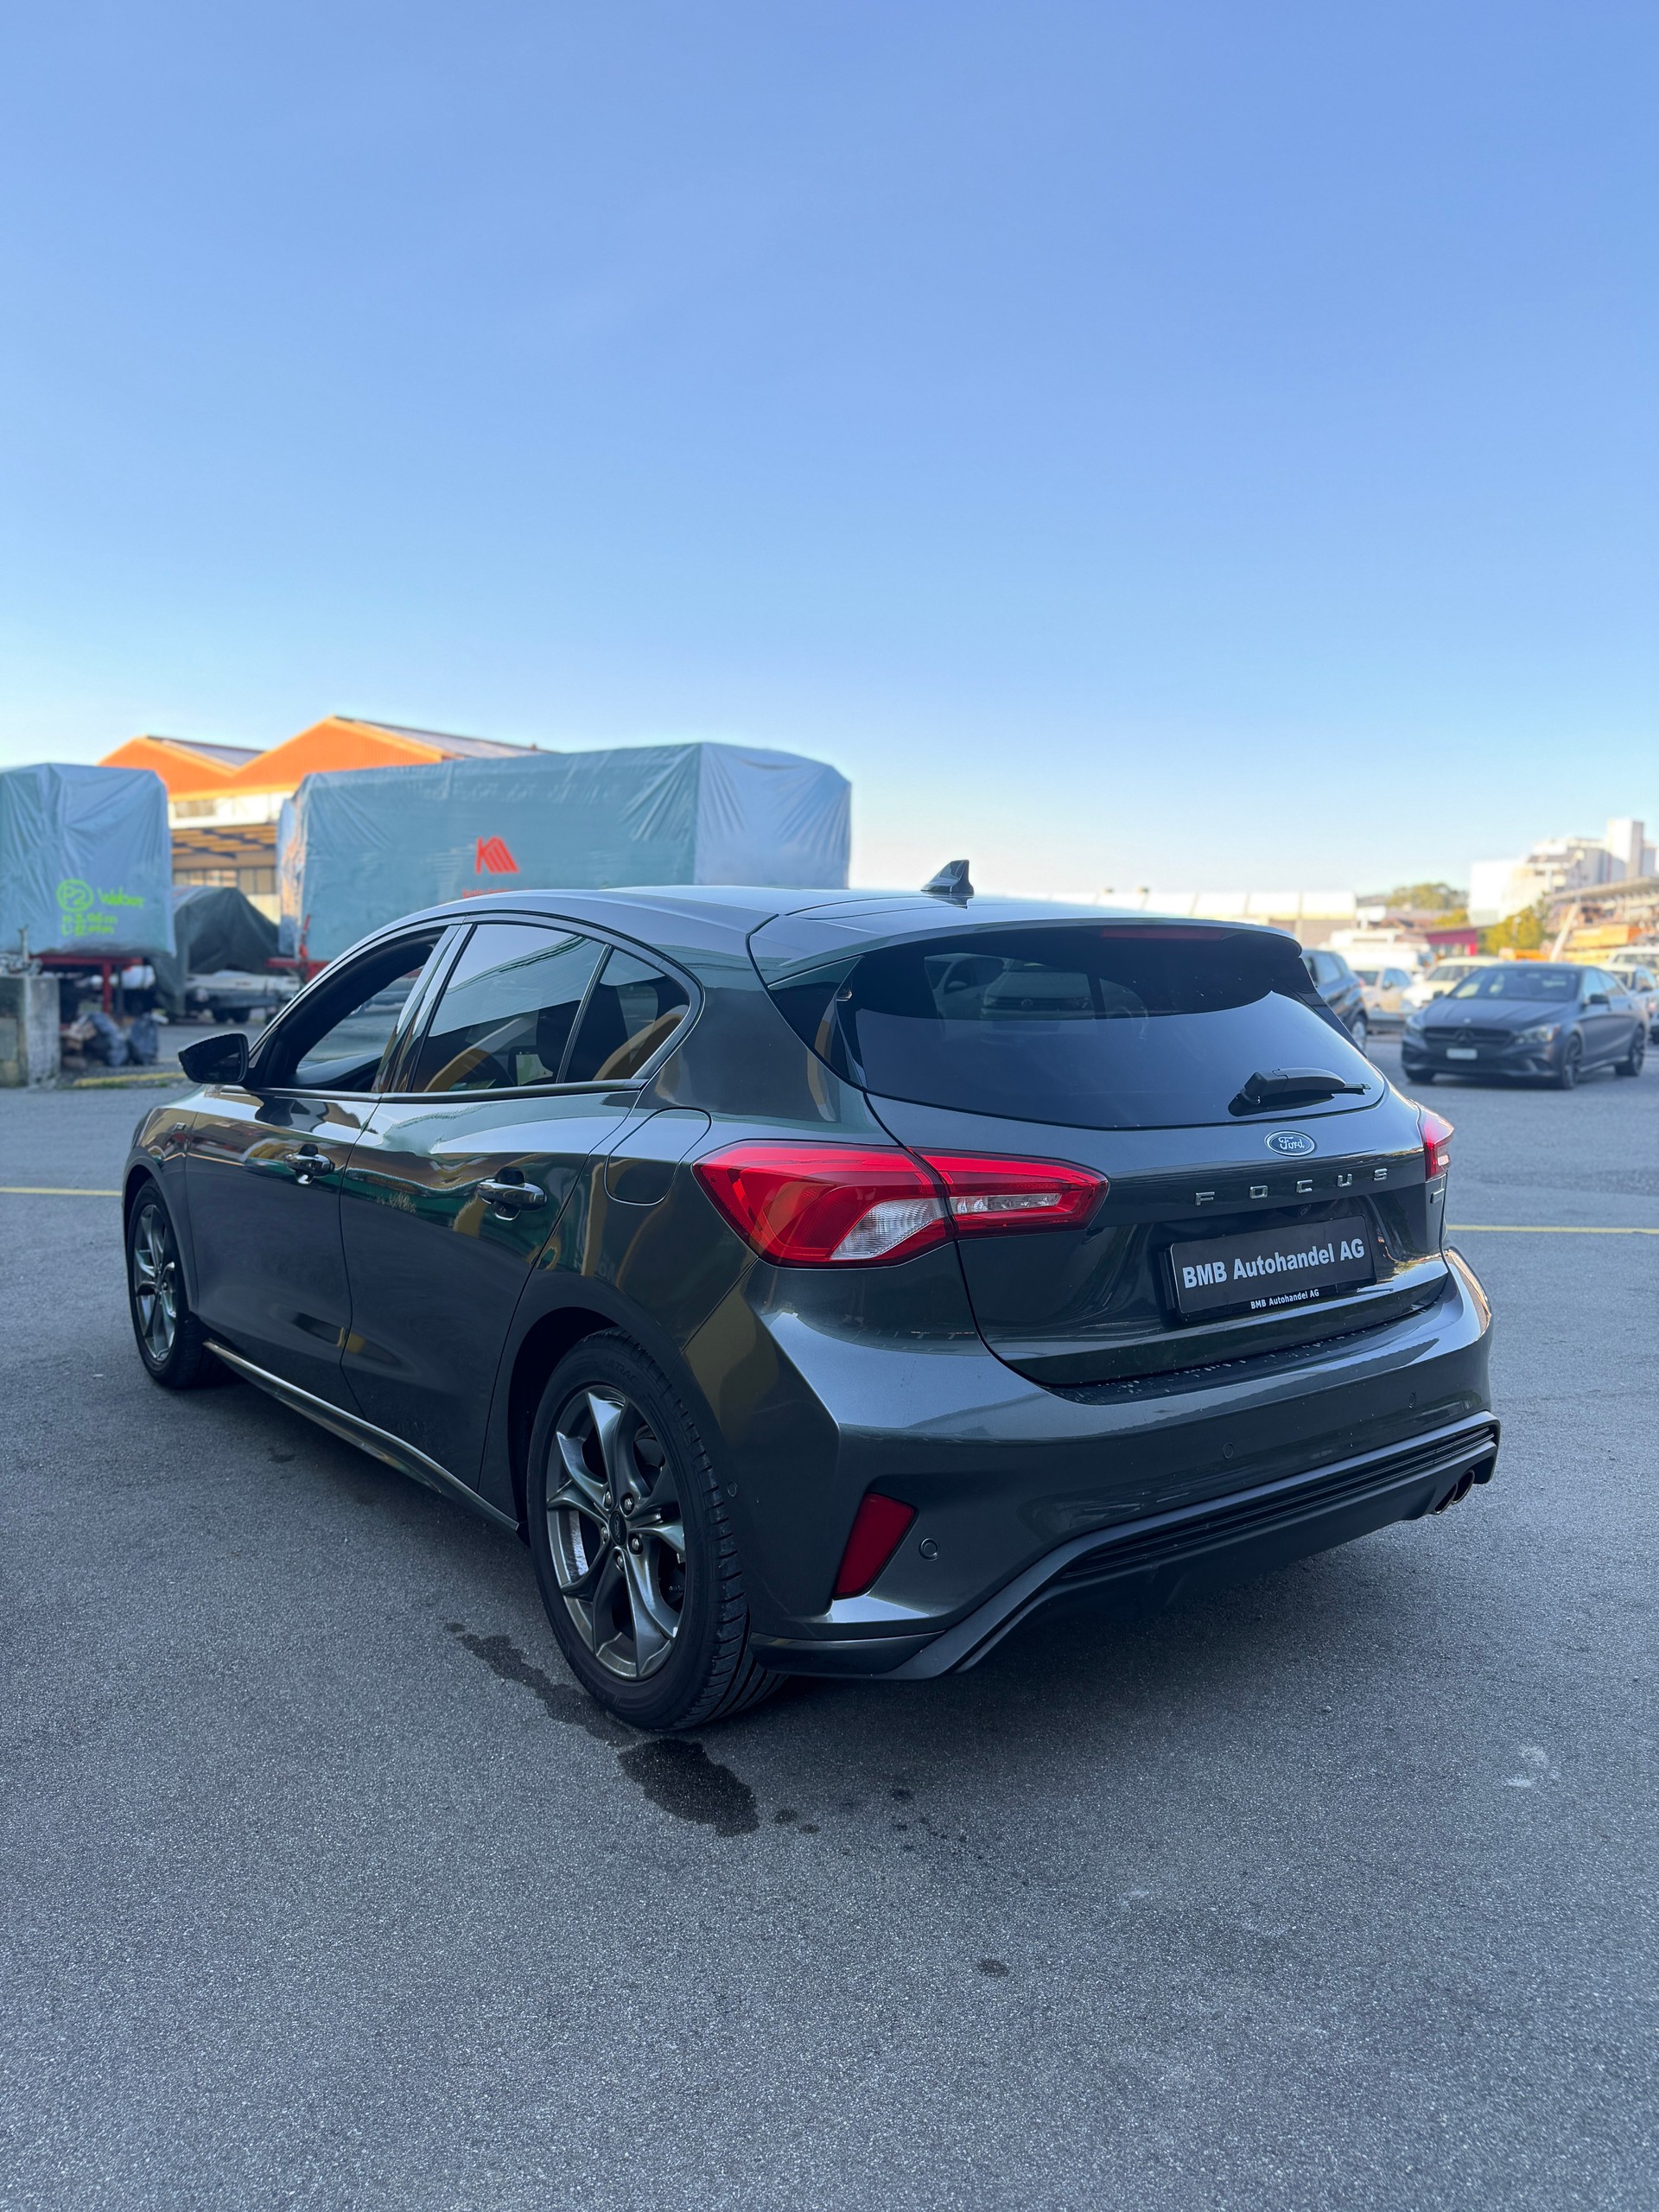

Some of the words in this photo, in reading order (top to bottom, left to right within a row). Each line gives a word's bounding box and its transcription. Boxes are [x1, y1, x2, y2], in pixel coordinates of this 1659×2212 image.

[1278, 1135, 1306, 1151] Ford
[1195, 1168, 1388, 1206] FOCUS
[1182, 1261, 1227, 1289] BMB
[1232, 1243, 1335, 1281] Autohandel
[1339, 1238, 1365, 1262] AG
[1250, 1299, 1267, 1310] BMB
[1268, 1291, 1308, 1306] Autohandel
[1309, 1289, 1320, 1299] AG
